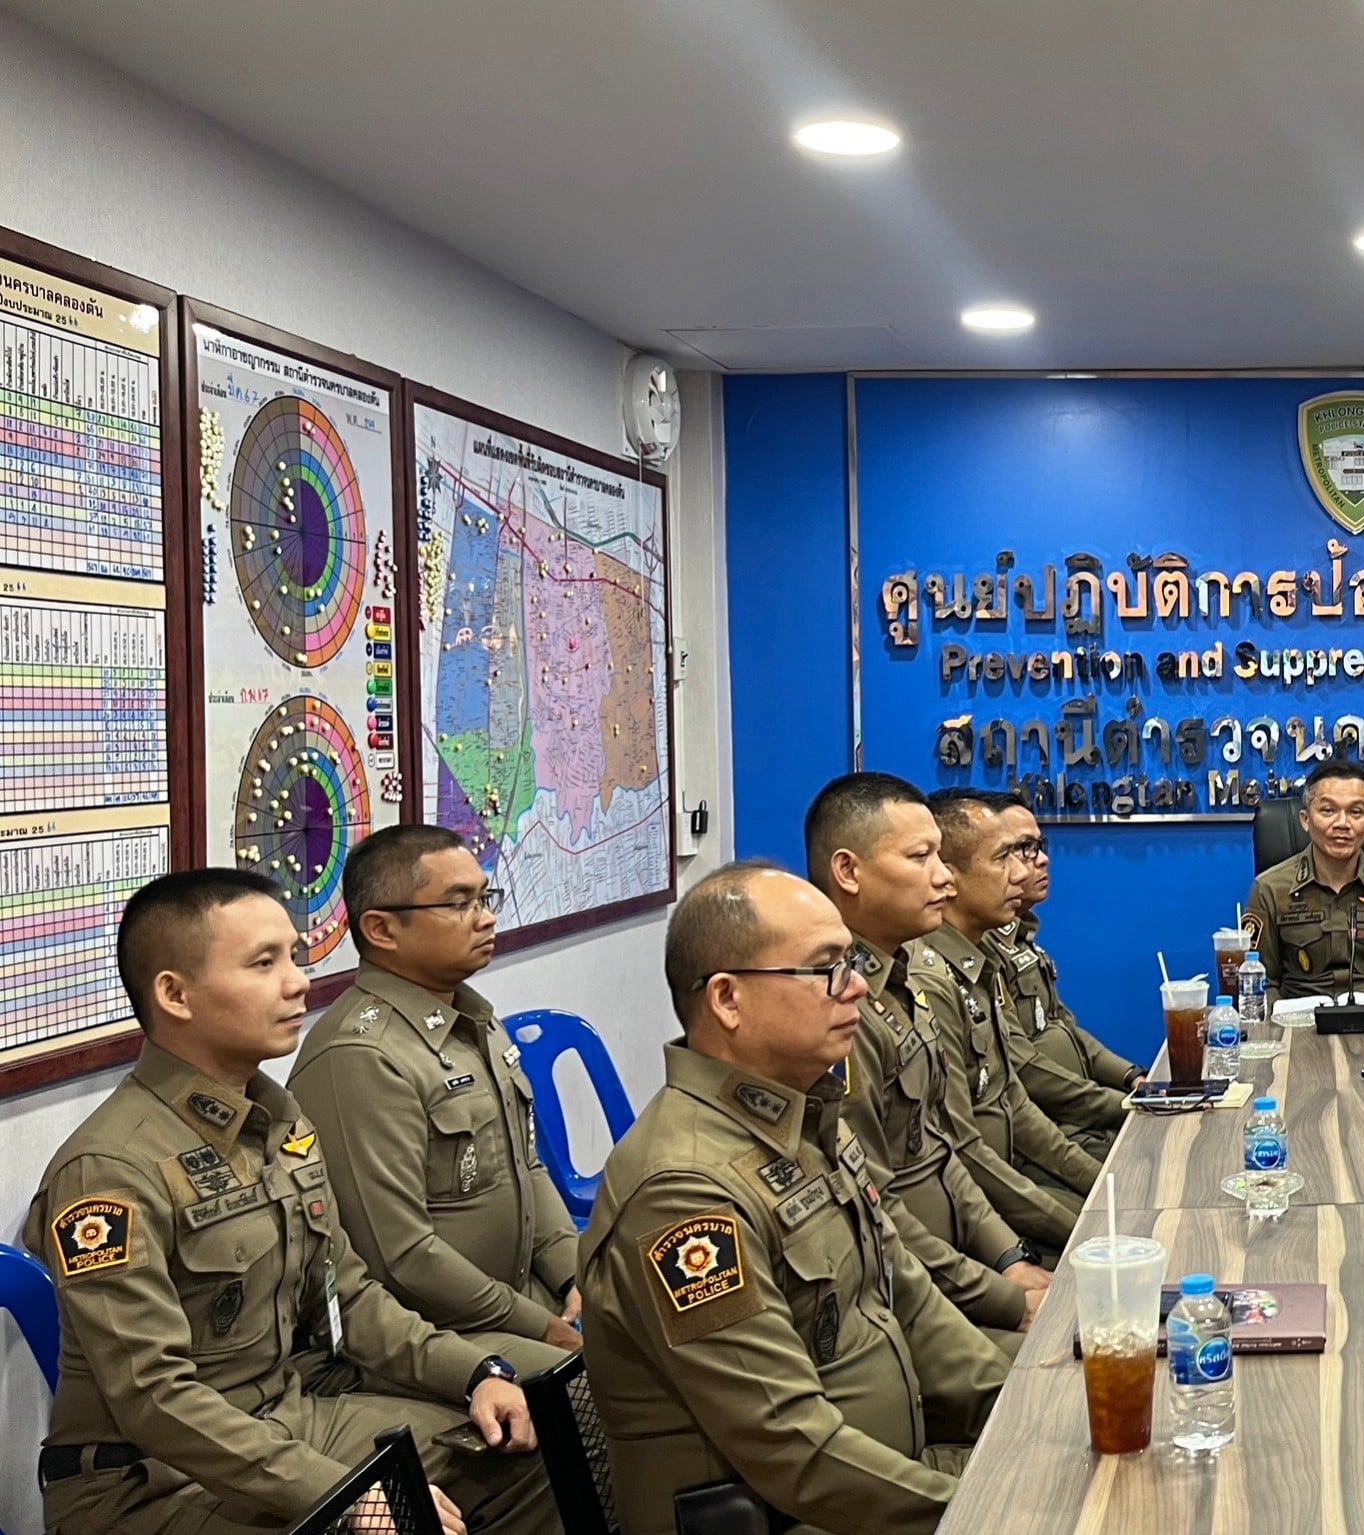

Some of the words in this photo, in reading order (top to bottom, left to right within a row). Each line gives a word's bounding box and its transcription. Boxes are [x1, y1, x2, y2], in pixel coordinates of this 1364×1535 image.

[1313, 406, 1364, 423] KHLONG
[1311, 443, 1346, 509] METROPOLITAN
[942, 642, 1145, 681] Prevention
[1156, 640, 1223, 679] and
[59, 1203, 124, 1230] ตำรวจนครบาล
[68, 1245, 123, 1265] METROPOLITAN
[653, 1222, 735, 1262] ตำรวจนครบาล
[76, 1254, 117, 1270] POLICE
[673, 1266, 738, 1298] METROPOLITAN
[687, 1279, 731, 1303] POLICE
